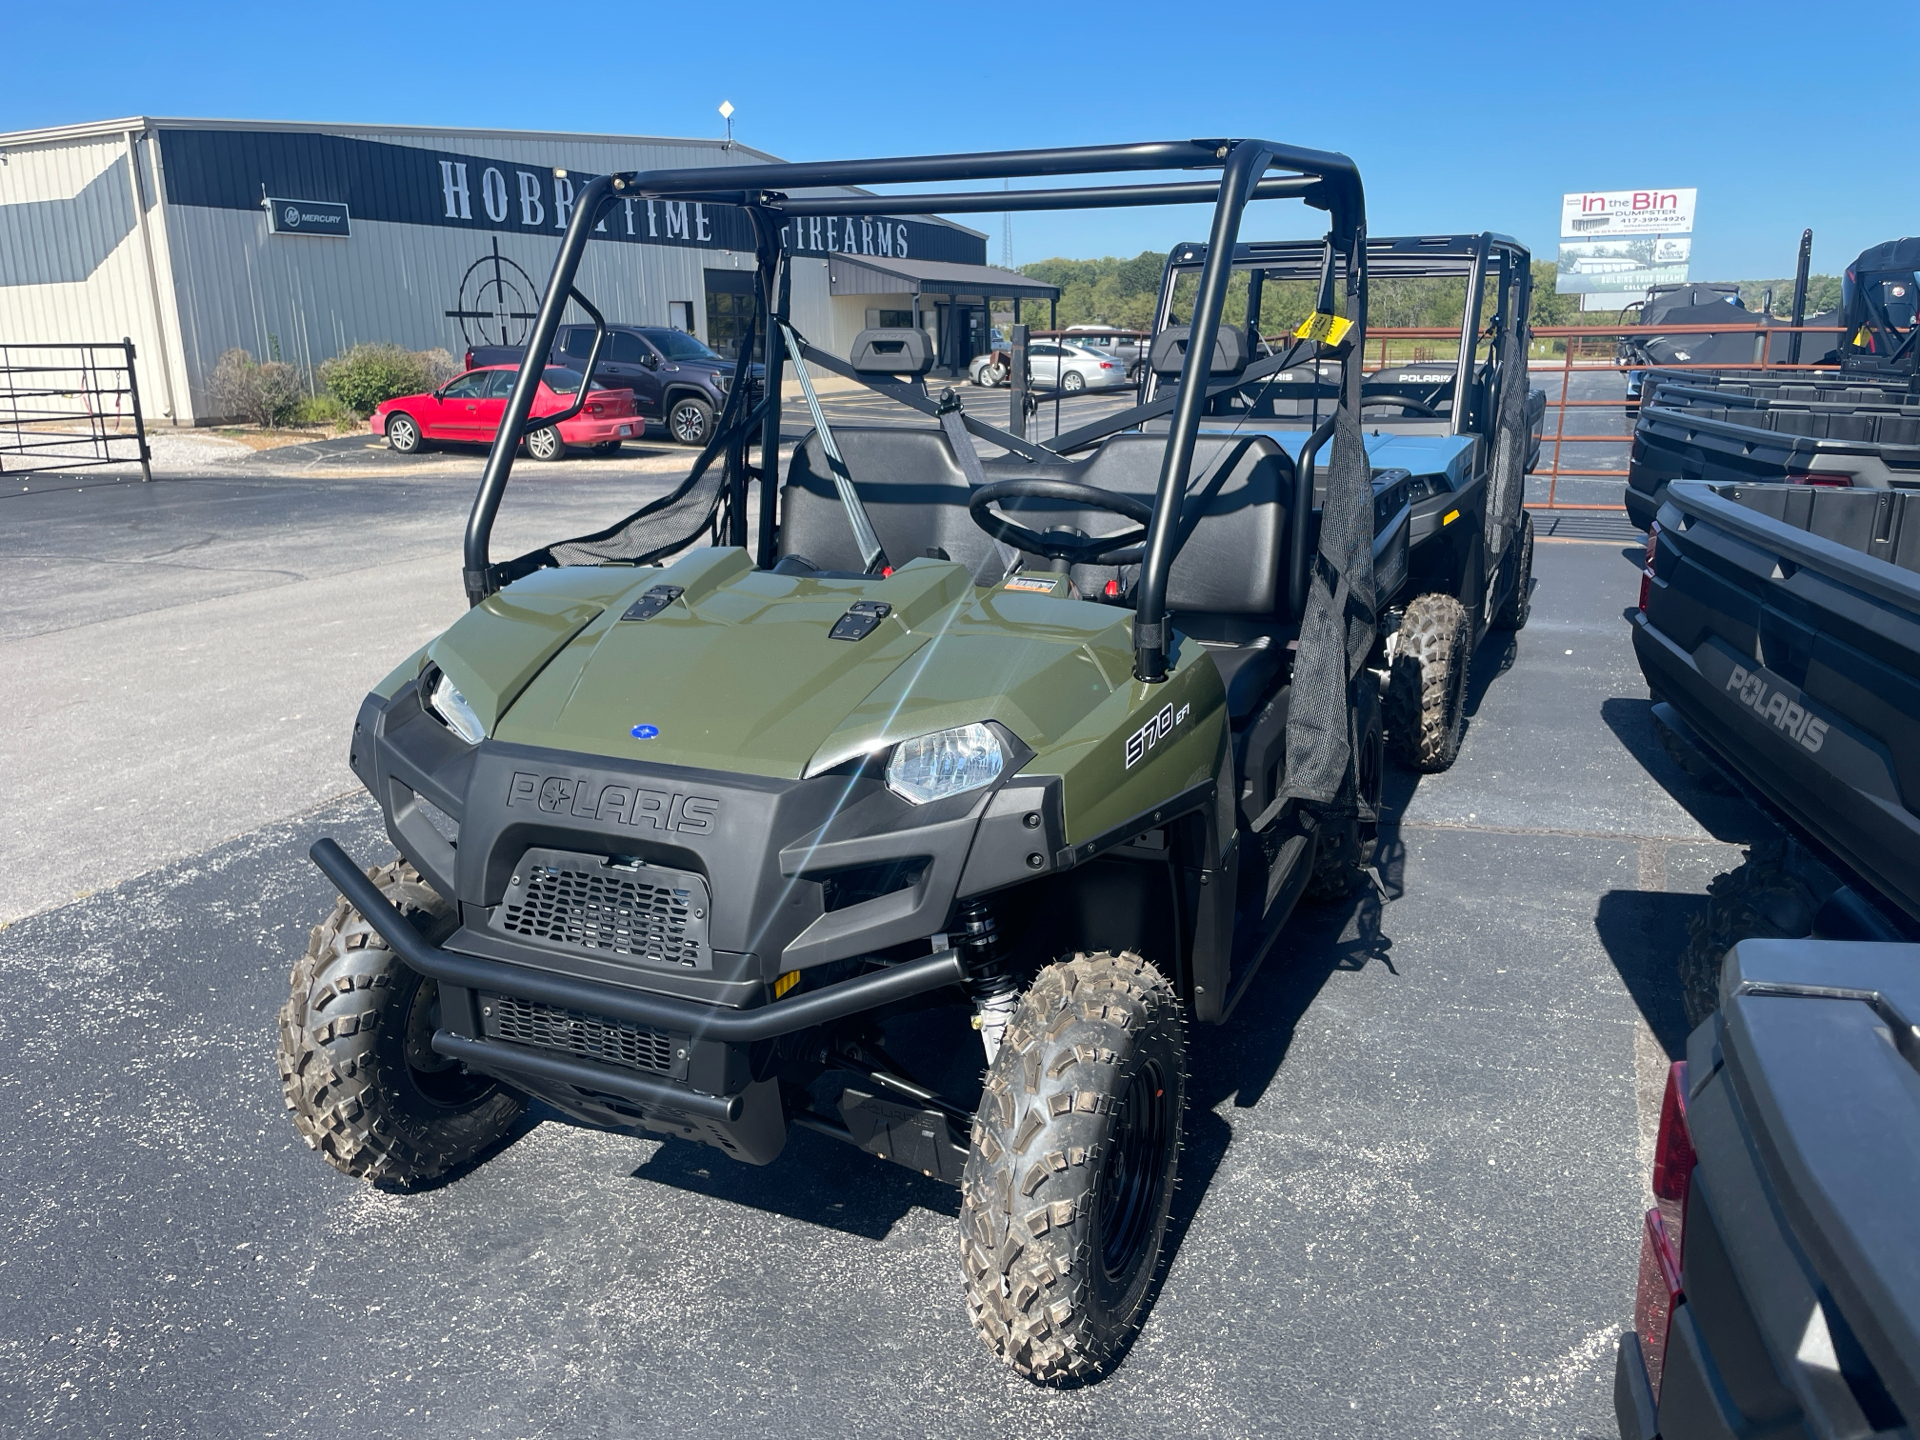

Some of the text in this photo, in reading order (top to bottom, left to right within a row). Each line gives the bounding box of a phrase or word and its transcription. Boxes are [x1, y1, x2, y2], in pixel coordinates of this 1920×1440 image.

[439, 160, 712, 242] HOBBTIME
[1582, 192, 1677, 212] In the Bin
[301, 213, 341, 223] MERCURY
[1615, 209, 1676, 217] DUMPSTER
[1620, 215, 1686, 224] 417-399-4926
[1601, 273, 1685, 284] BUILDING YOUR DREAMS
[1399, 374, 1451, 383] POLARIS
[1726, 664, 1830, 753] POLARIS
[1126, 702, 1190, 770] 570 EFI
[507, 771, 720, 836] POLARIS
